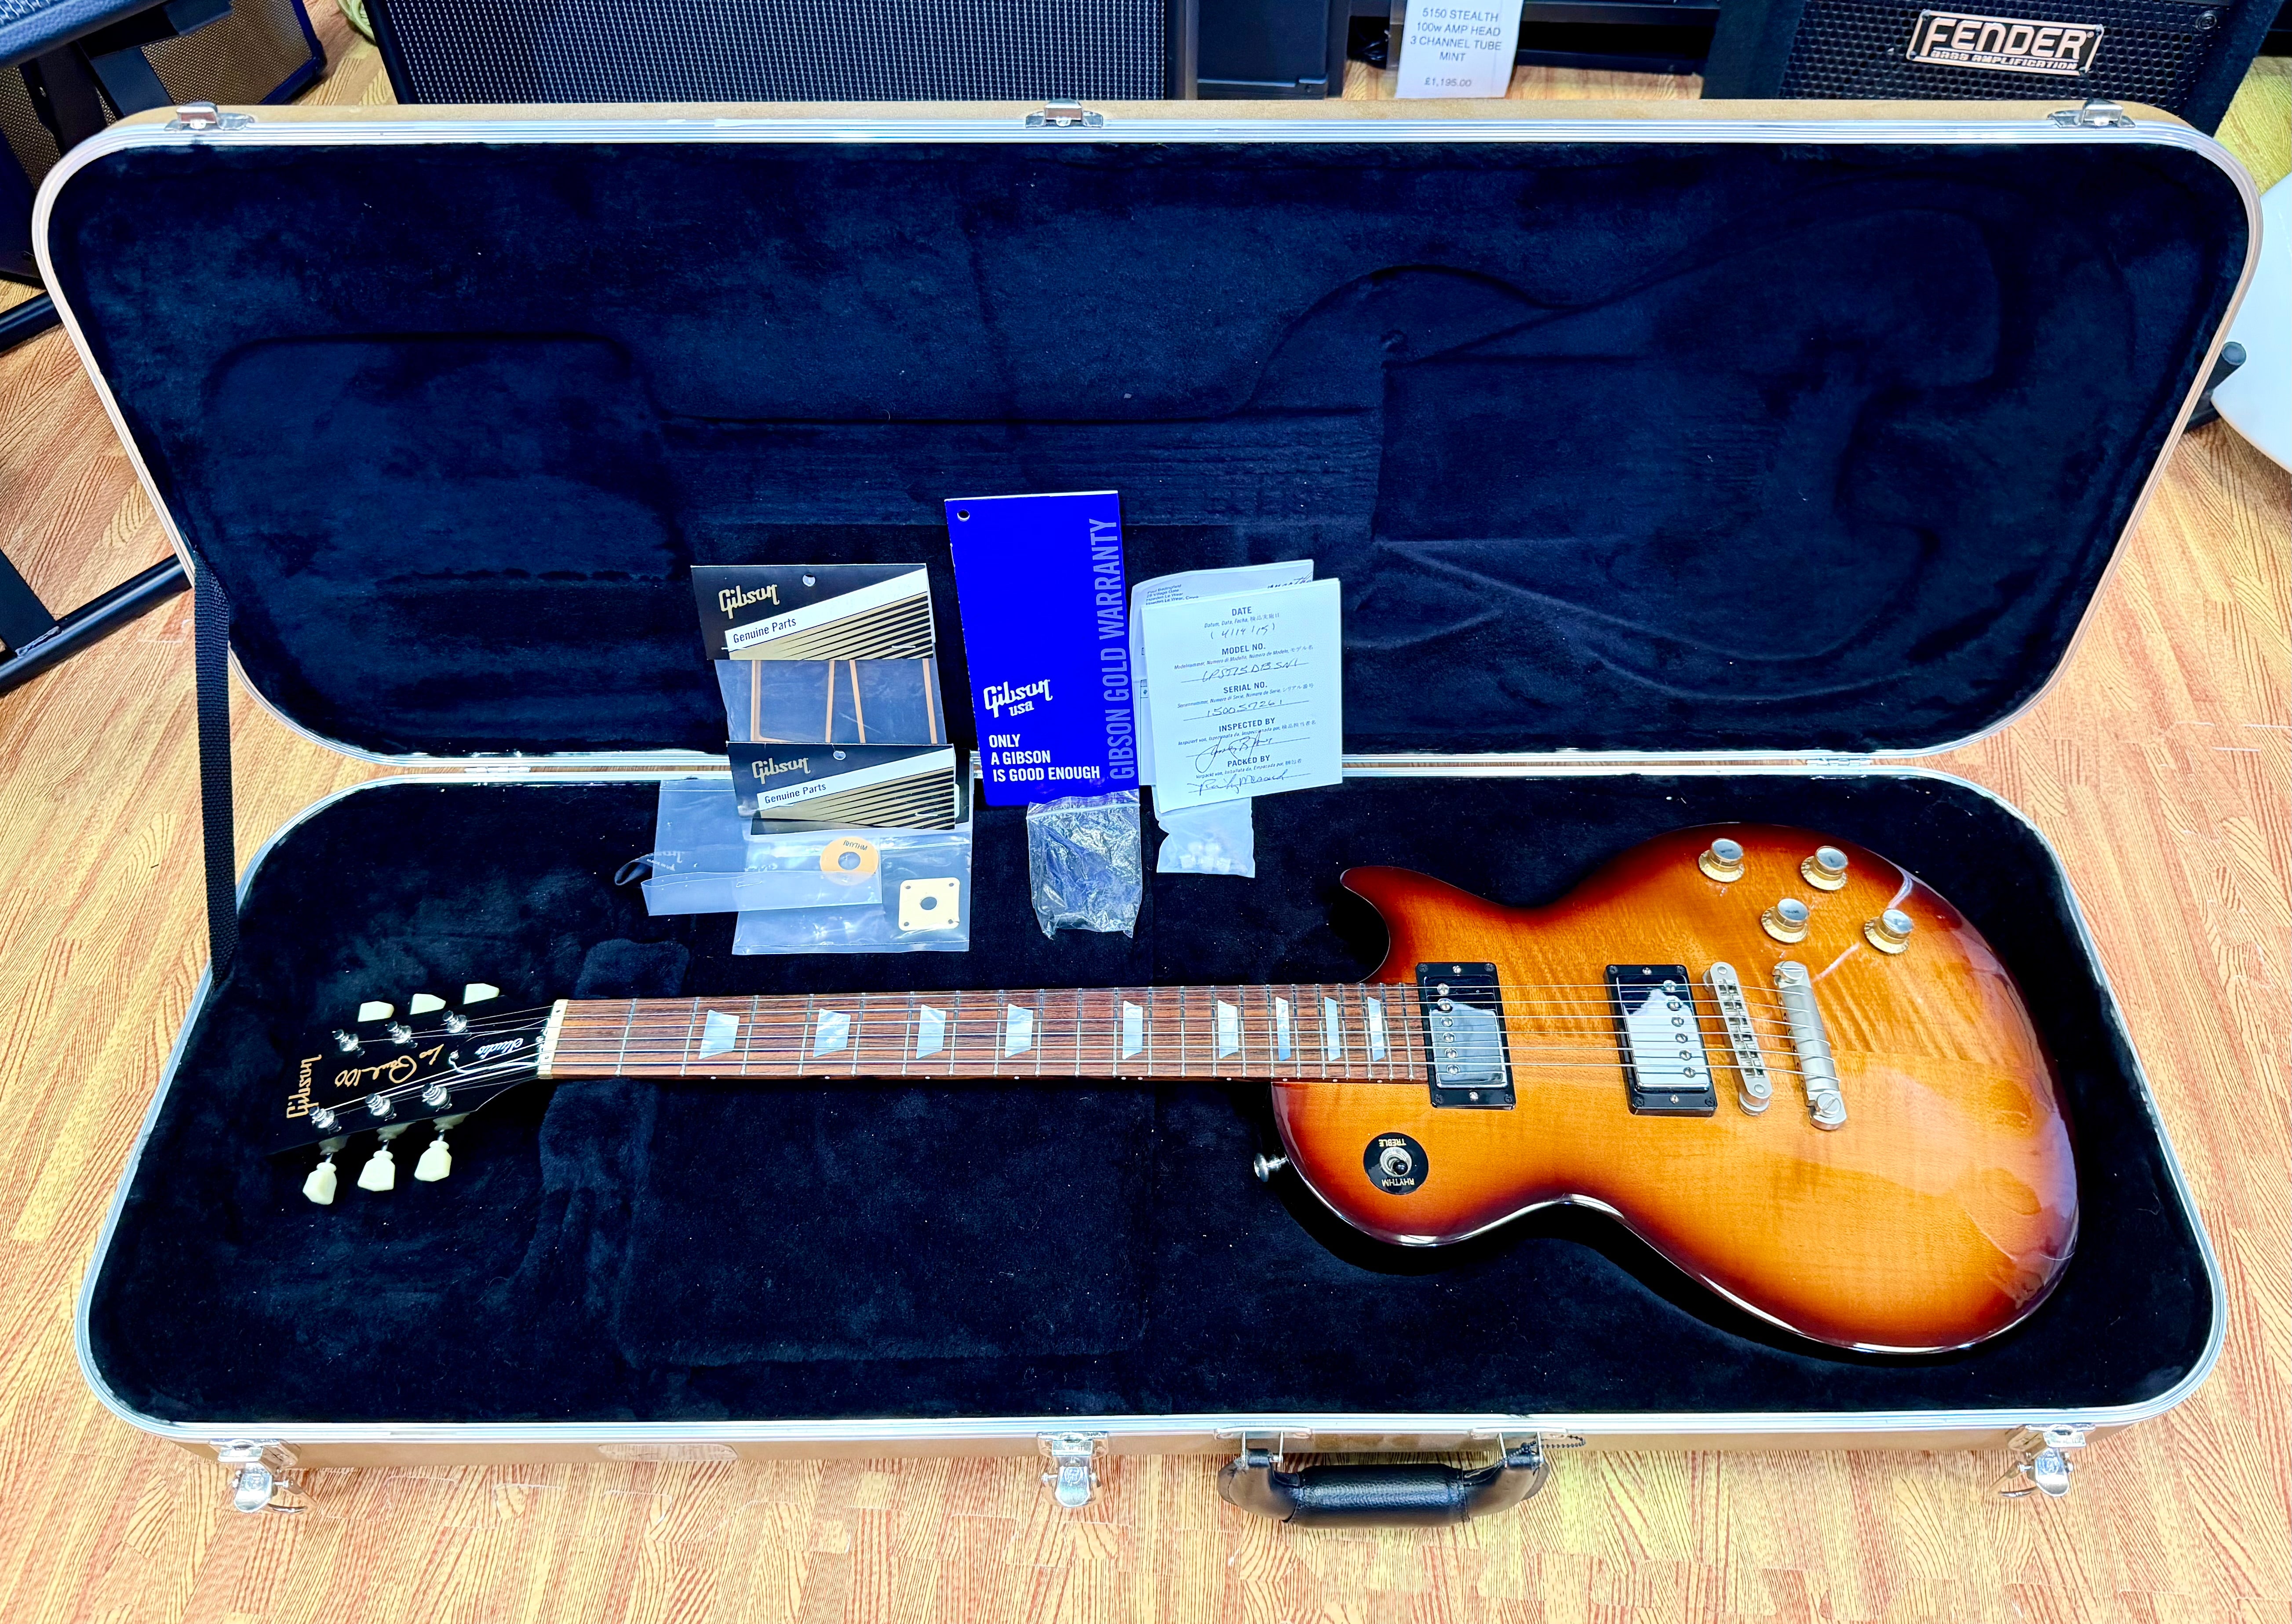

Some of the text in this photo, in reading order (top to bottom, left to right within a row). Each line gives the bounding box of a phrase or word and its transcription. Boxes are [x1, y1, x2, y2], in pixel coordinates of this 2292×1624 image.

[1422, 8, 1499, 22] 5150 STEALTH
[1417, 22, 1501, 36] 100w AMP HEAD
[1410, 36, 1502, 51] 3 CHANNEL TUBE
[1921, 17, 2087, 59] FENDER
[1439, 51, 1466, 62] MINT
[1931, 50, 2078, 70] BASS AMPLIFICATION
[1424, 77, 1472, 87] £1,195.00
[718, 584, 780, 619] Gibson
[1232, 606, 1252, 616] DATE
[733, 618, 796, 643] Genuine Parts
[1089, 518, 1135, 779] GIBSON GOLD WARRANTY
[1222, 645, 1249, 655] MODEL
[1223, 683, 1251, 693] SERIAL
[983, 679, 1053, 718] Gibson
[1008, 701, 1035, 717] usa
[1219, 719, 1262, 732] INSPECTED
[988, 734, 1020, 748] ONLY
[991, 750, 1051, 765] A GIBSON
[1228, 757, 1257, 767] PACKED
[751, 757, 811, 784] Gibson
[993, 765, 1100, 782] IS GOOD ENOUGH
[765, 784, 826, 804] Genuine Parts
[843, 840, 867, 851] RHYTHM
[474, 1038, 523, 1060] Studio
[287, 1054, 322, 1118] Gibson
[1378, 1138, 1407, 1147] TREBLE
[1381, 1178, 1415, 1187] RHYTHM
